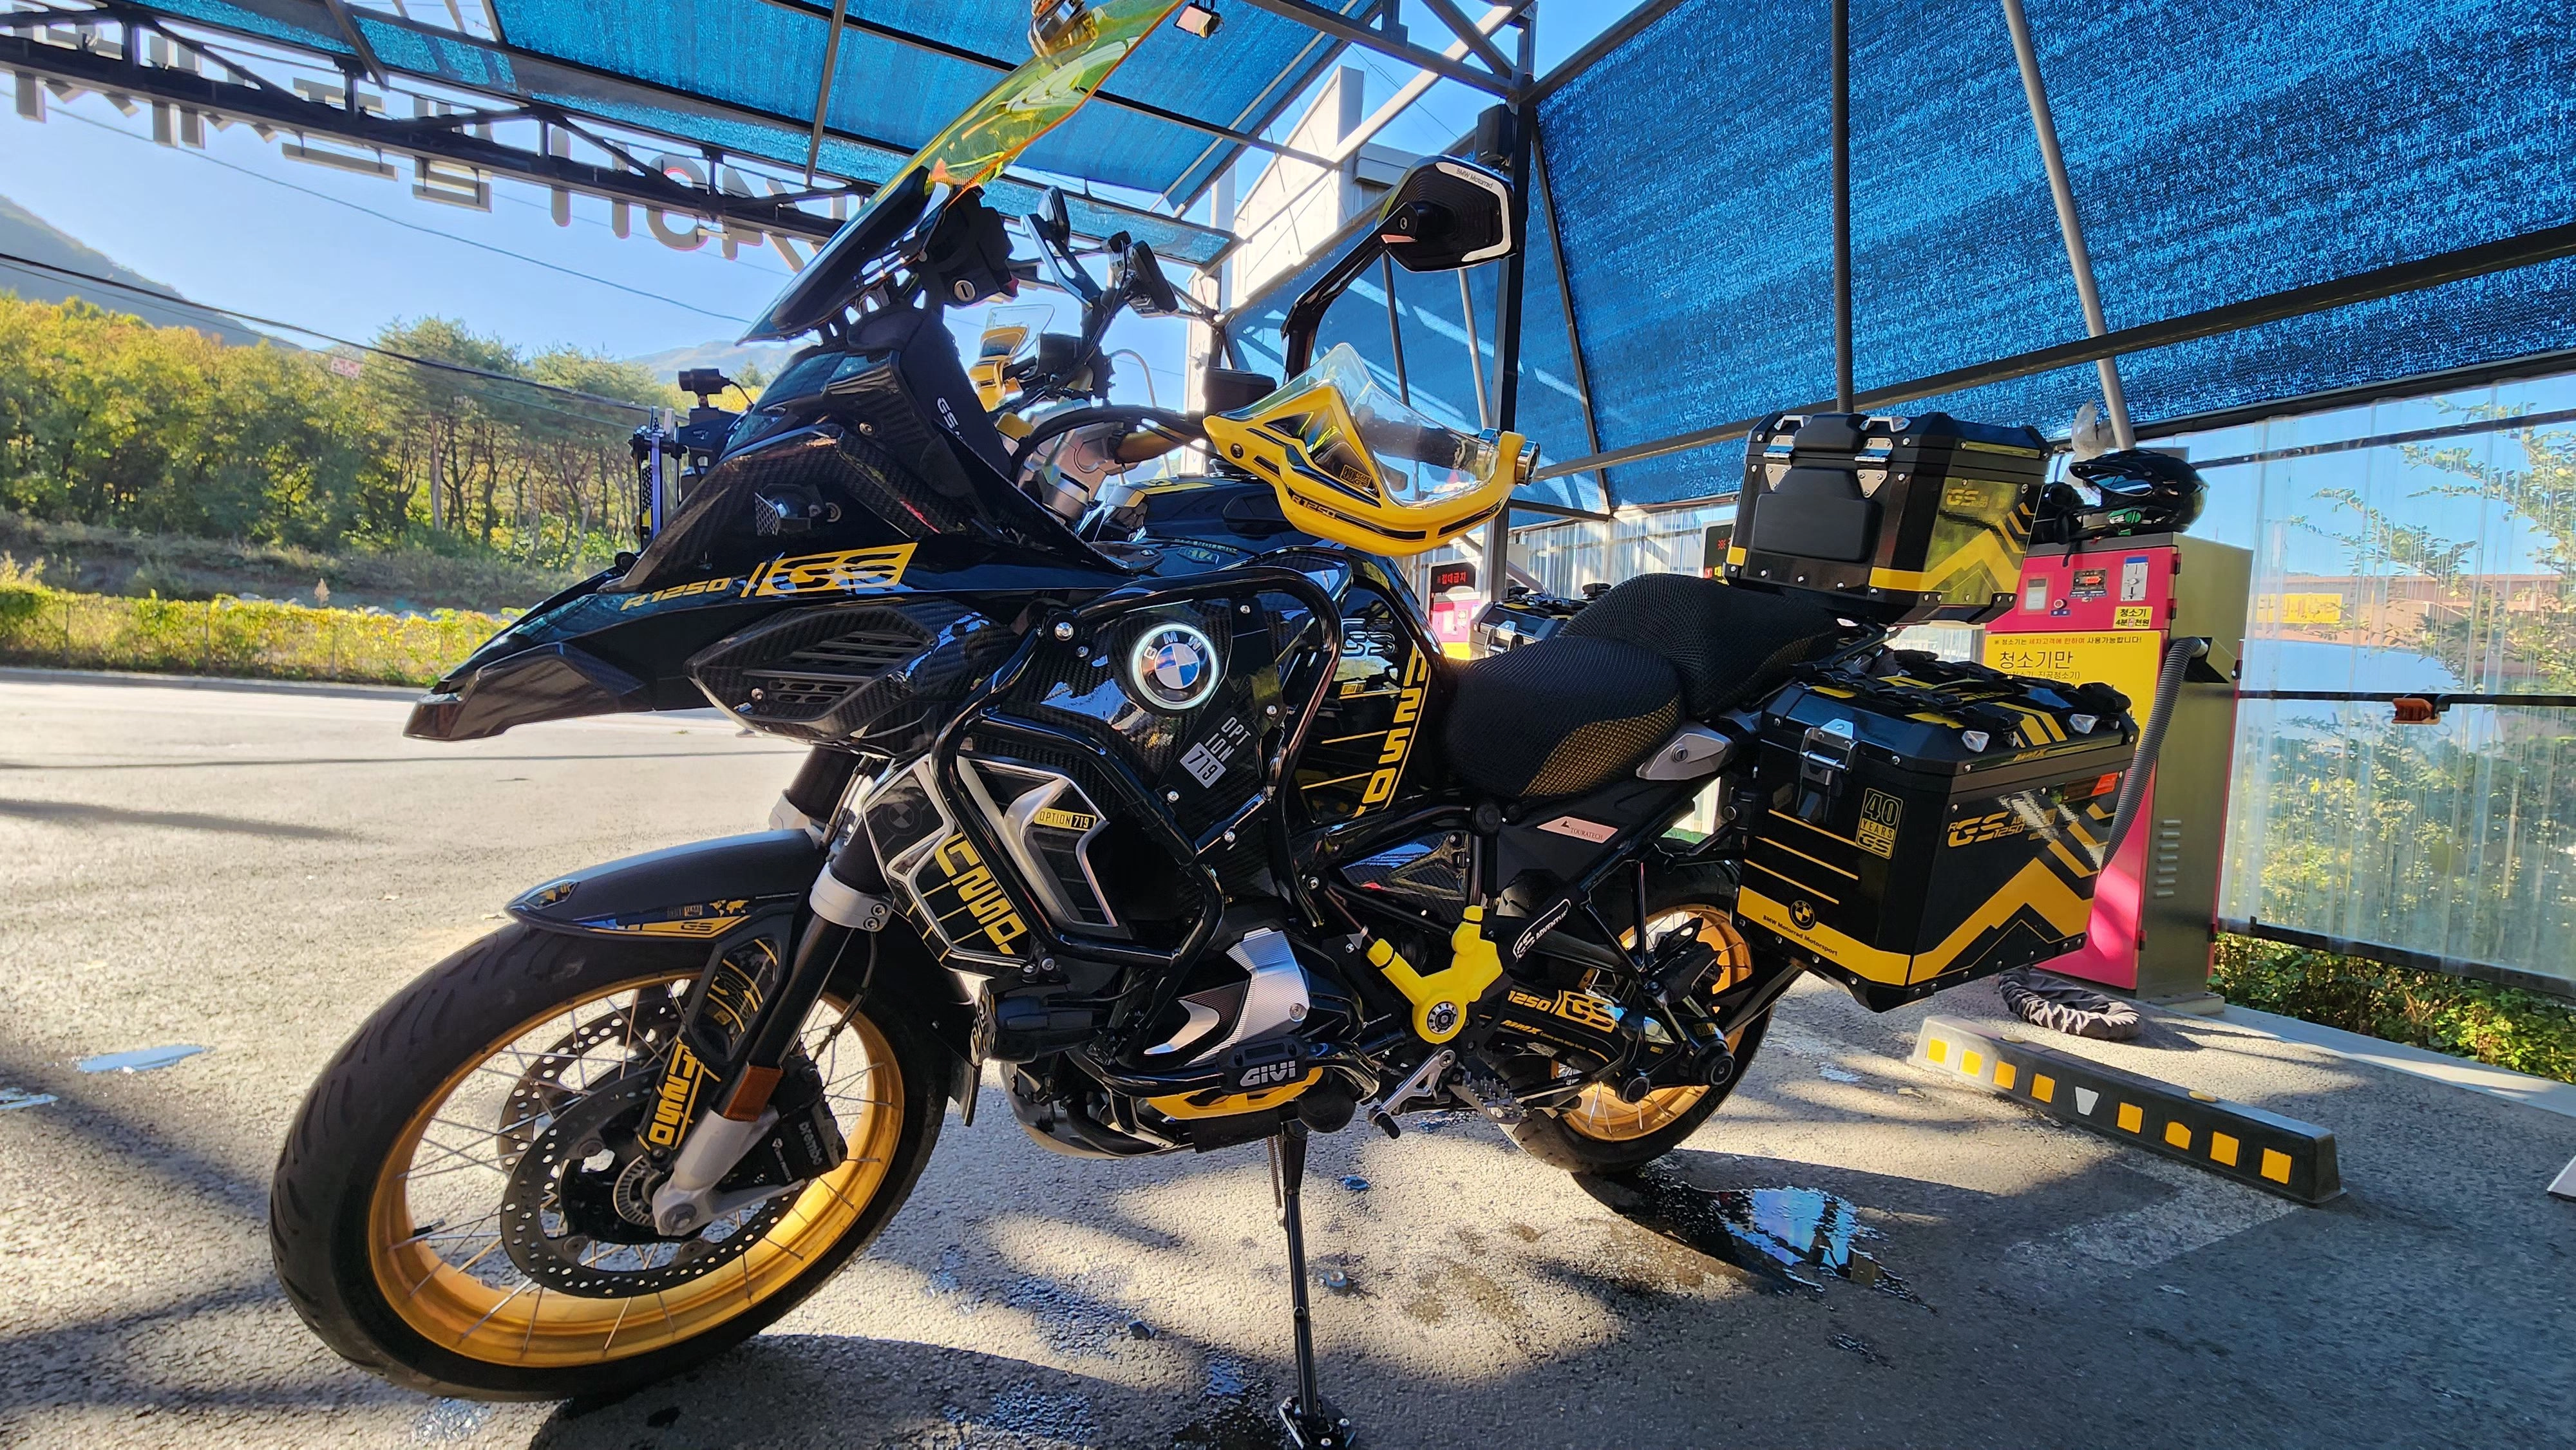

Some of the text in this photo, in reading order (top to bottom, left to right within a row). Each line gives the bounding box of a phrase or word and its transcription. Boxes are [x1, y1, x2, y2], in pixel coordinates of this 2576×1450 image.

[1456, 168, 1469, 178] BMW
[2120, 608, 2146, 617] 청소기
[1144, 631, 1201, 660] BMW
[2000, 651, 2073, 669] 청소기만
[1221, 717, 1251, 746] OPT
[1205, 733, 1235, 762] ION
[1188, 750, 1218, 780] 719
[1039, 811, 1090, 829] OPTION 719
[1865, 793, 1899, 825] 40
[1570, 827, 1603, 840] TOURATECH
[1862, 819, 1894, 839] YEARS
[1948, 811, 2009, 847] GS
[1993, 825, 2025, 838] 1250
[1859, 834, 1891, 854] GS
[681, 921, 714, 932] GS
[1763, 914, 1837, 956] BMW Motorrad Motorsport
[1508, 990, 1551, 1012] 1250
[799, 1121, 824, 1166] brembo
